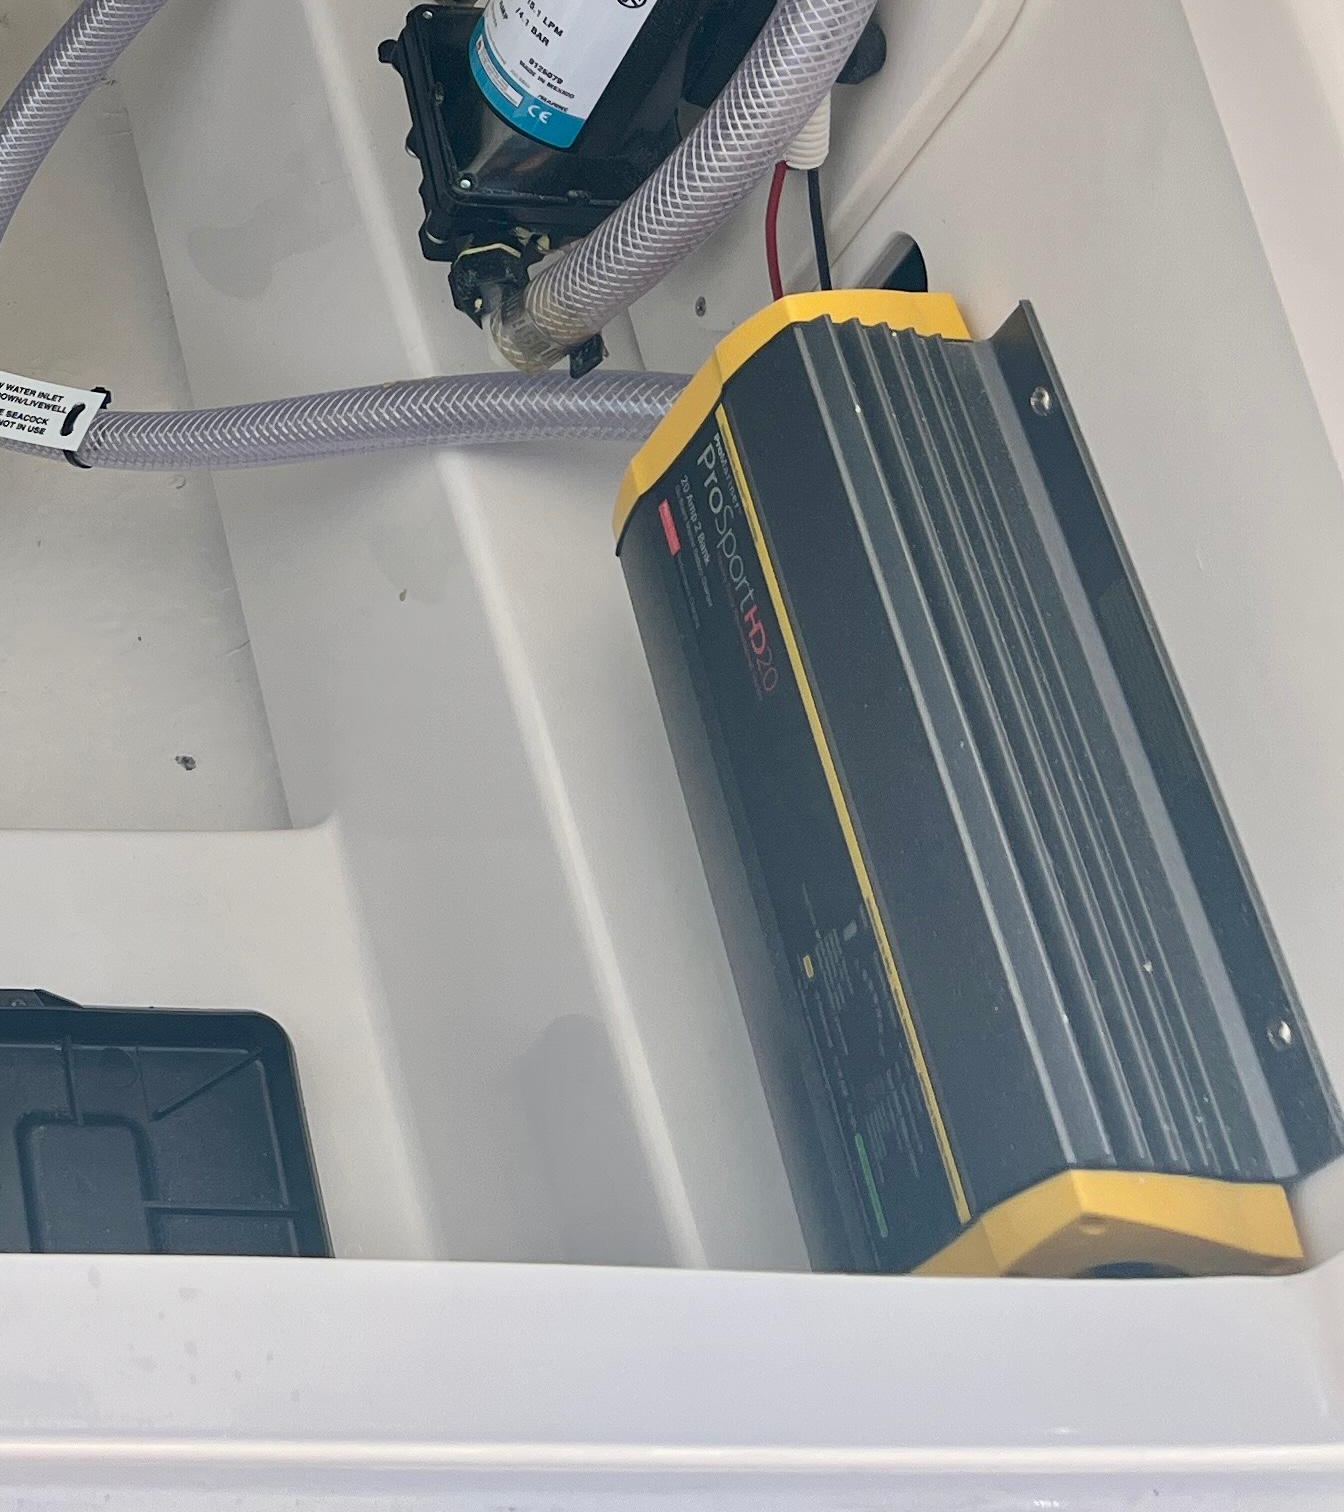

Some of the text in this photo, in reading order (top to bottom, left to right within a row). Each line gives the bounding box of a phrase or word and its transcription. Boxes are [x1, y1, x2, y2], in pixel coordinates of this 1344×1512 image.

[531, 26, 550, 47] BAR
[542, 16, 564, 37] LPM
[5, 382, 37, 397] WATER
[38, 390, 64, 403] INLET
[6, 410, 49, 425] SEACOCK
[16, 423, 26, 431] IN
[27, 425, 47, 435] USE
[714, 432, 741, 512] ProMariner
[680, 474, 692, 495] 20
[686, 494, 698, 524] Amp
[697, 534, 711, 568] Bank
